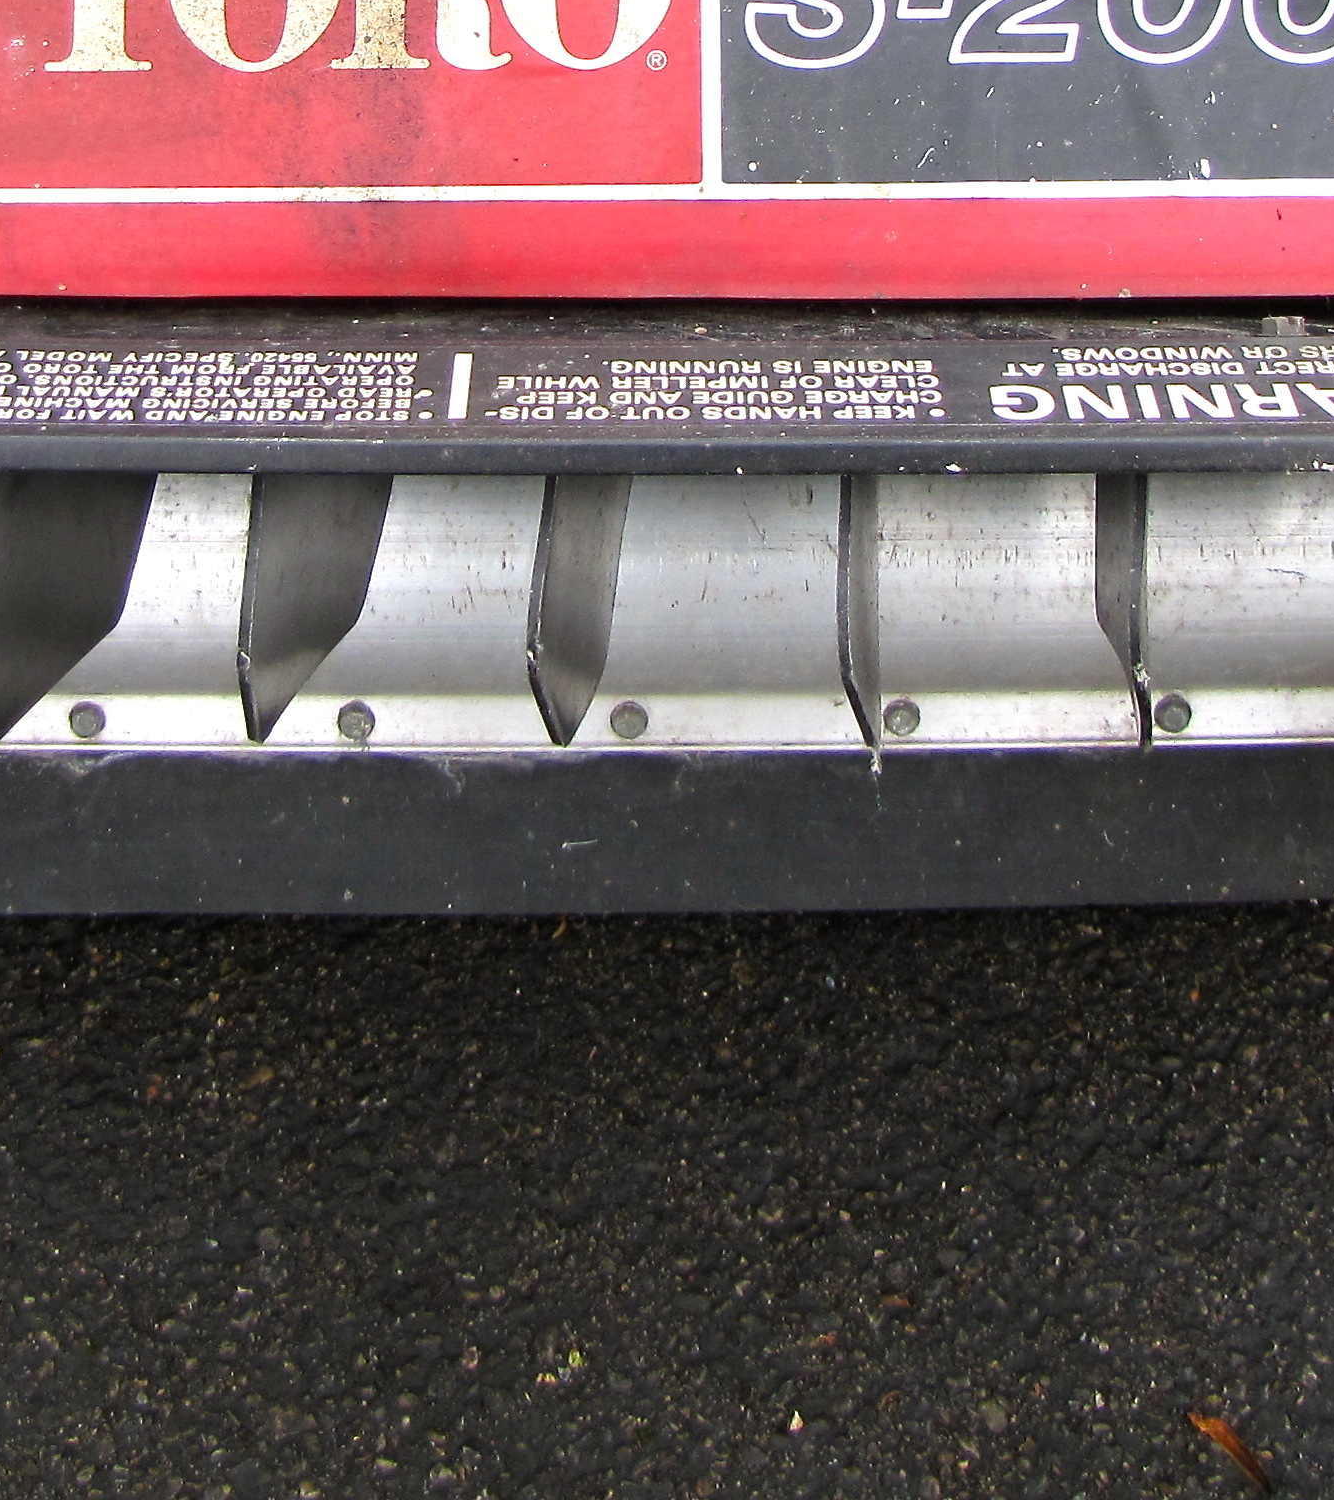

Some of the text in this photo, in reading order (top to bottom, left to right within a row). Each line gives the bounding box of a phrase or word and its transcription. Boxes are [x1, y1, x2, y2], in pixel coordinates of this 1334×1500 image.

[15, 350, 112, 363] MODEL
[122, 351, 235, 363] SPECIFY
[1051, 346, 1228, 361] WINDOWS.
[1241, 345, 1288, 359] OR
[23, 362, 98, 375] TORO
[108, 363, 162, 375] THE
[171, 363, 254, 375] FROM
[261, 364, 417, 375] AVAILABLE
[601, 359, 933, 374] ENGINE IS RUNNING.
[1001, 363, 1045, 377] AT
[1054, 361, 1244, 377] DISCHARGE
[28, 373, 243, 386] INSTRUCTIONS.
[252, 374, 414, 387] OPERATING
[497, 374, 940, 389] CLEAR OF IMPELLER WHILE
[15, 384, 139, 397] MANUAL
[149, 386, 326, 398] OPERATOR'S
[338, 387, 414, 398] READ
[515, 389, 943, 405] CHARGE GUIDE AND KEEP
[142, 397, 293, 409] SERVICING
[301, 397, 413, 409] BEFORE
[53, 409, 135, 421] WAIT
[145, 410, 209, 421] AND
[217, 409, 325, 421] ENGINE
[335, 410, 410, 421] STOP
[483, 405, 916, 421] KEEP HANDS OUT OF DIS-
